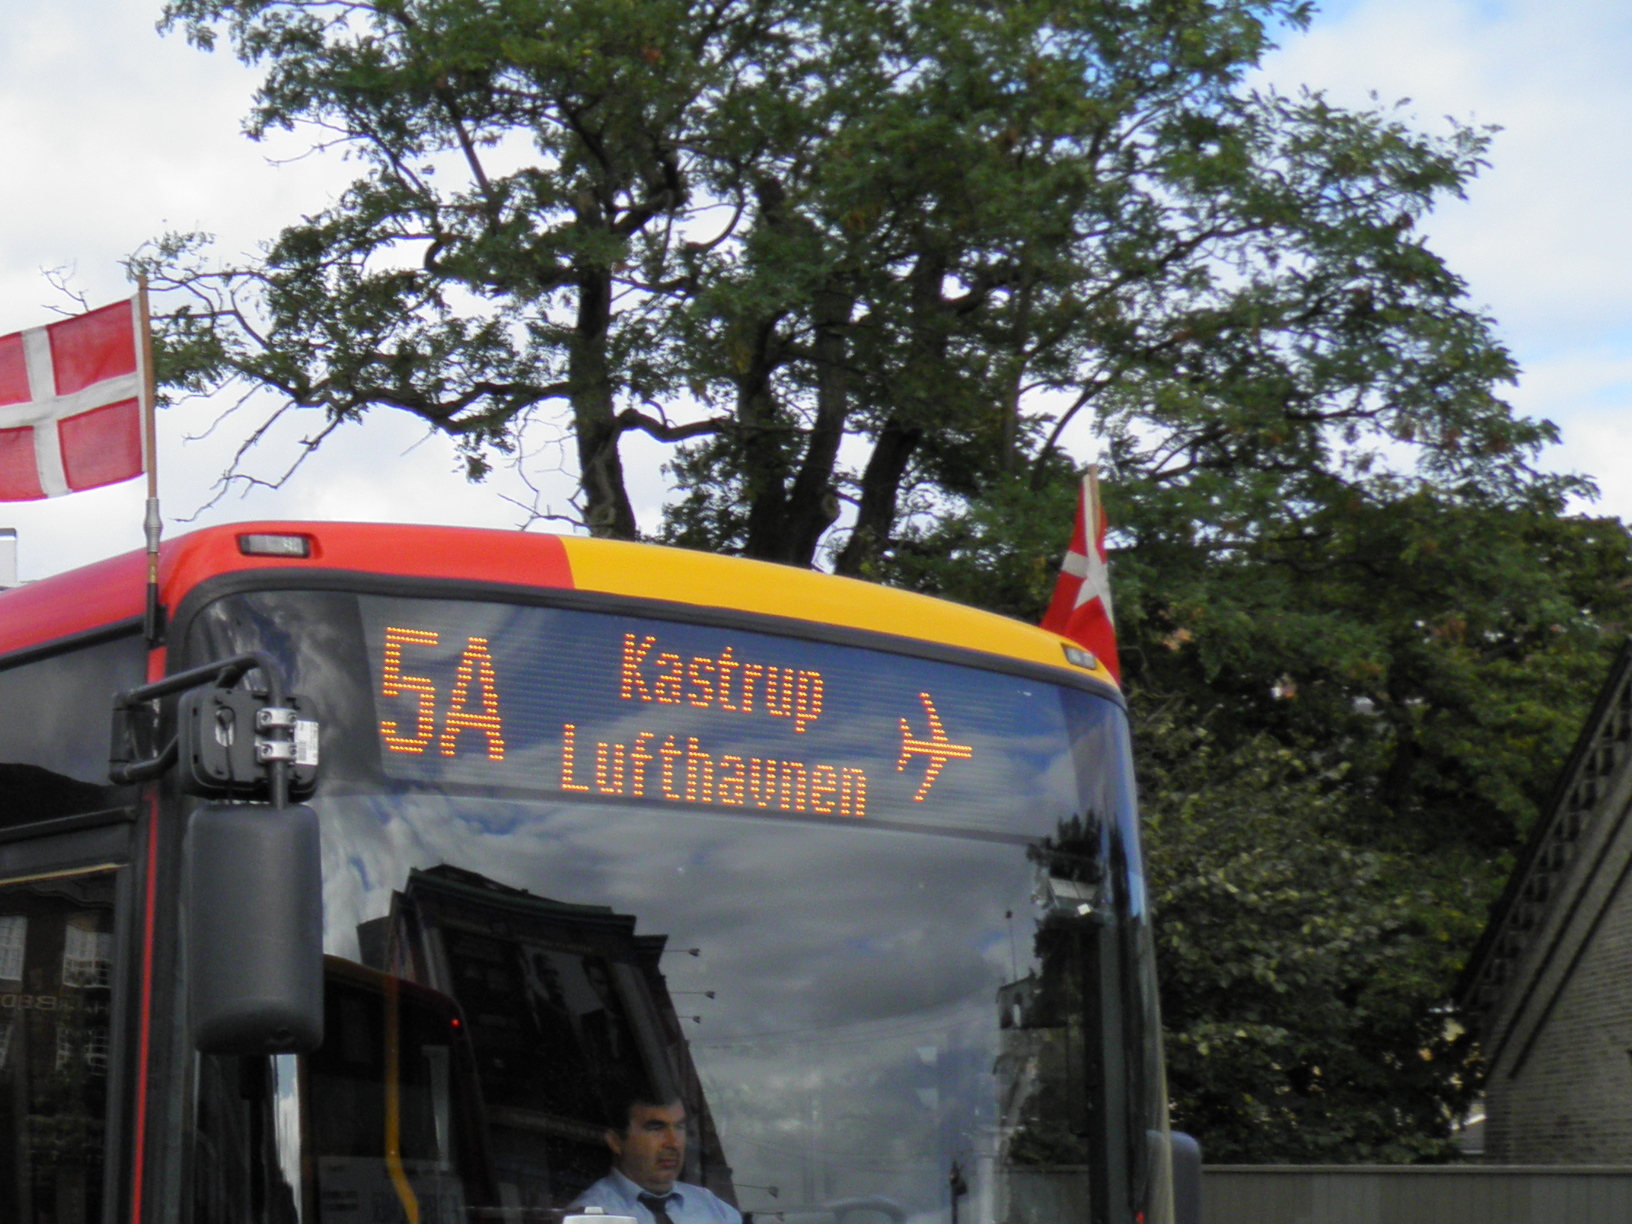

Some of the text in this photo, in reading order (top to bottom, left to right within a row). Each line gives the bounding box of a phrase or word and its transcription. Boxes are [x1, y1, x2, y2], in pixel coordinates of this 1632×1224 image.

[381, 626, 505, 761] 5A
[621, 633, 824, 733] Kastrup
[562, 723, 866, 816] Lufthavnen
